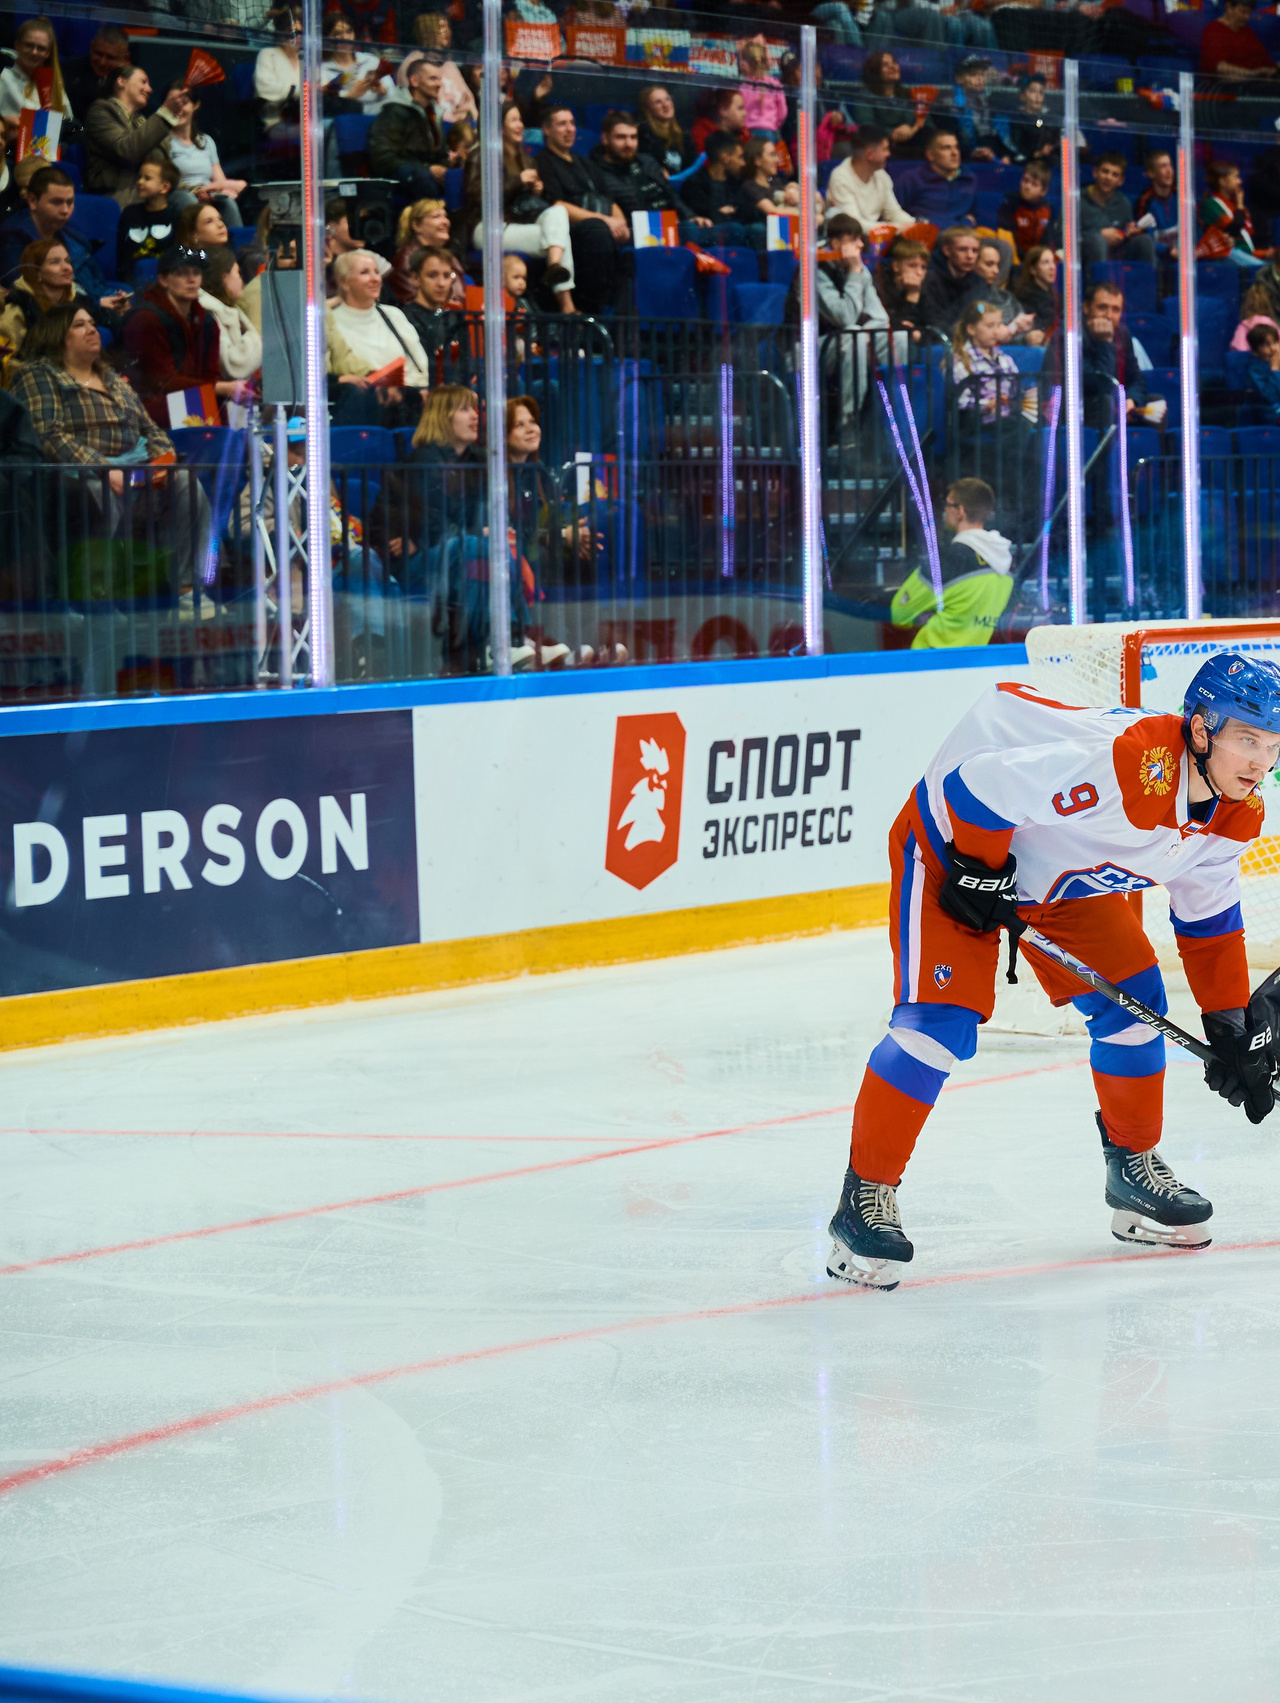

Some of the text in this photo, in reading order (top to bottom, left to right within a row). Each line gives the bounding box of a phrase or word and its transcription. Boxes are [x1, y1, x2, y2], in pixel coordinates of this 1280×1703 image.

[1198, 686, 1216, 701] CCM
[706, 729, 861, 805] СПОРТ
[1051, 781, 1100, 817] 9
[12, 792, 370, 908] DERSON
[702, 805, 853, 859] ЭКСПРЕСС
[957, 874, 1018, 892] BAU
[1089, 866, 1150, 892] СХ
[1125, 1004, 1191, 1047] BAUER
